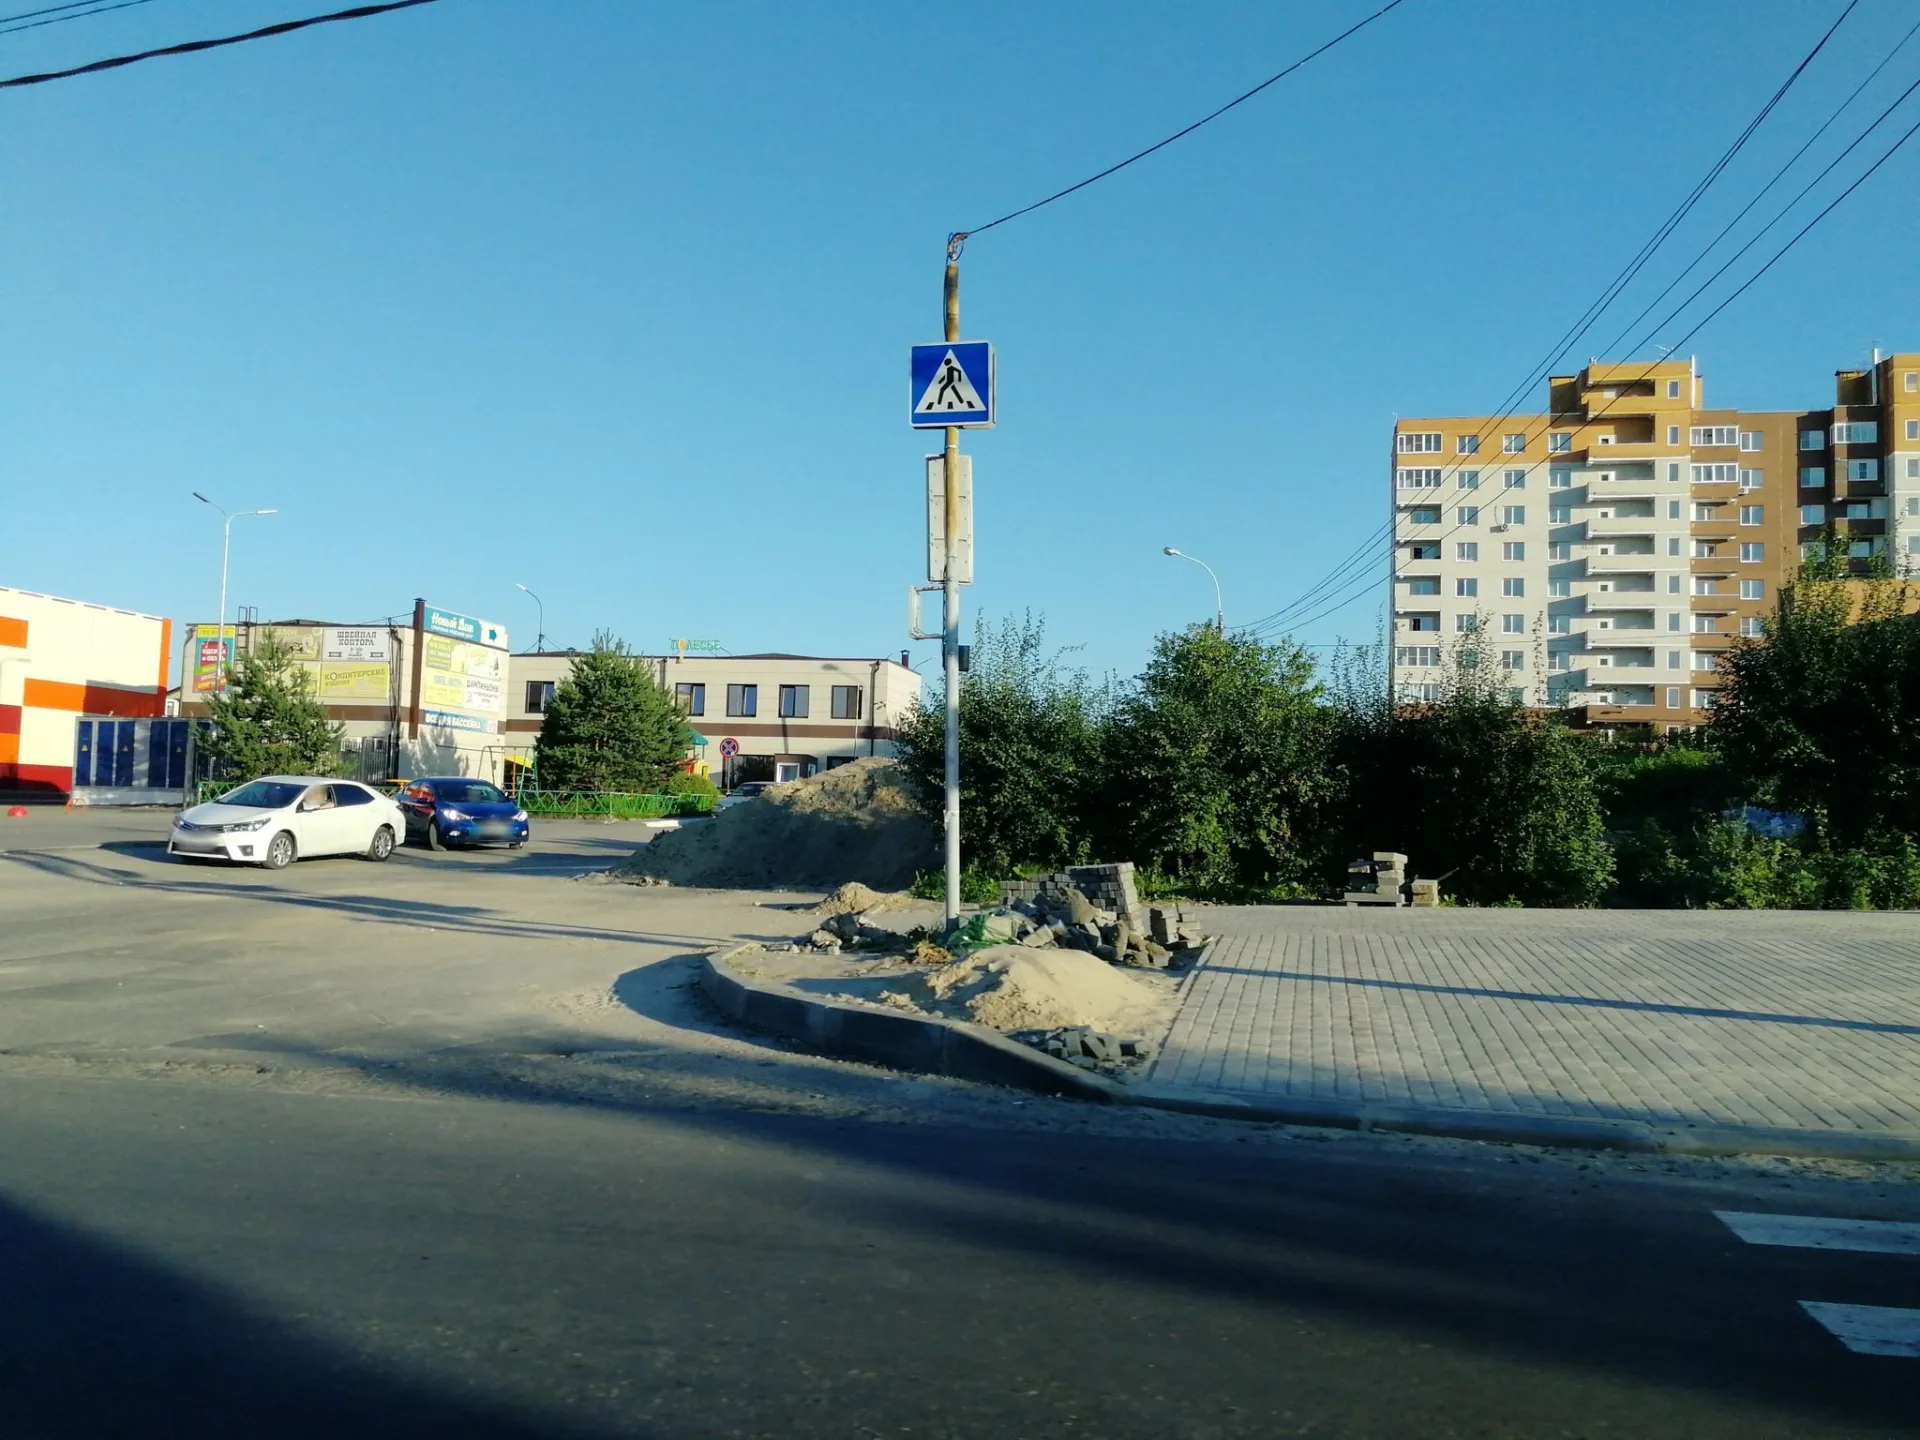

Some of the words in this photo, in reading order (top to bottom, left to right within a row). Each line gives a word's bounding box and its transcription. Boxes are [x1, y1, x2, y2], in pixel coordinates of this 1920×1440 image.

[337, 630, 377, 639] ШВЕЙНАЯ
[202, 648, 227, 656] ОДЕЖА
[324, 668, 386, 681] КОНДИТЕРСКИЕ
